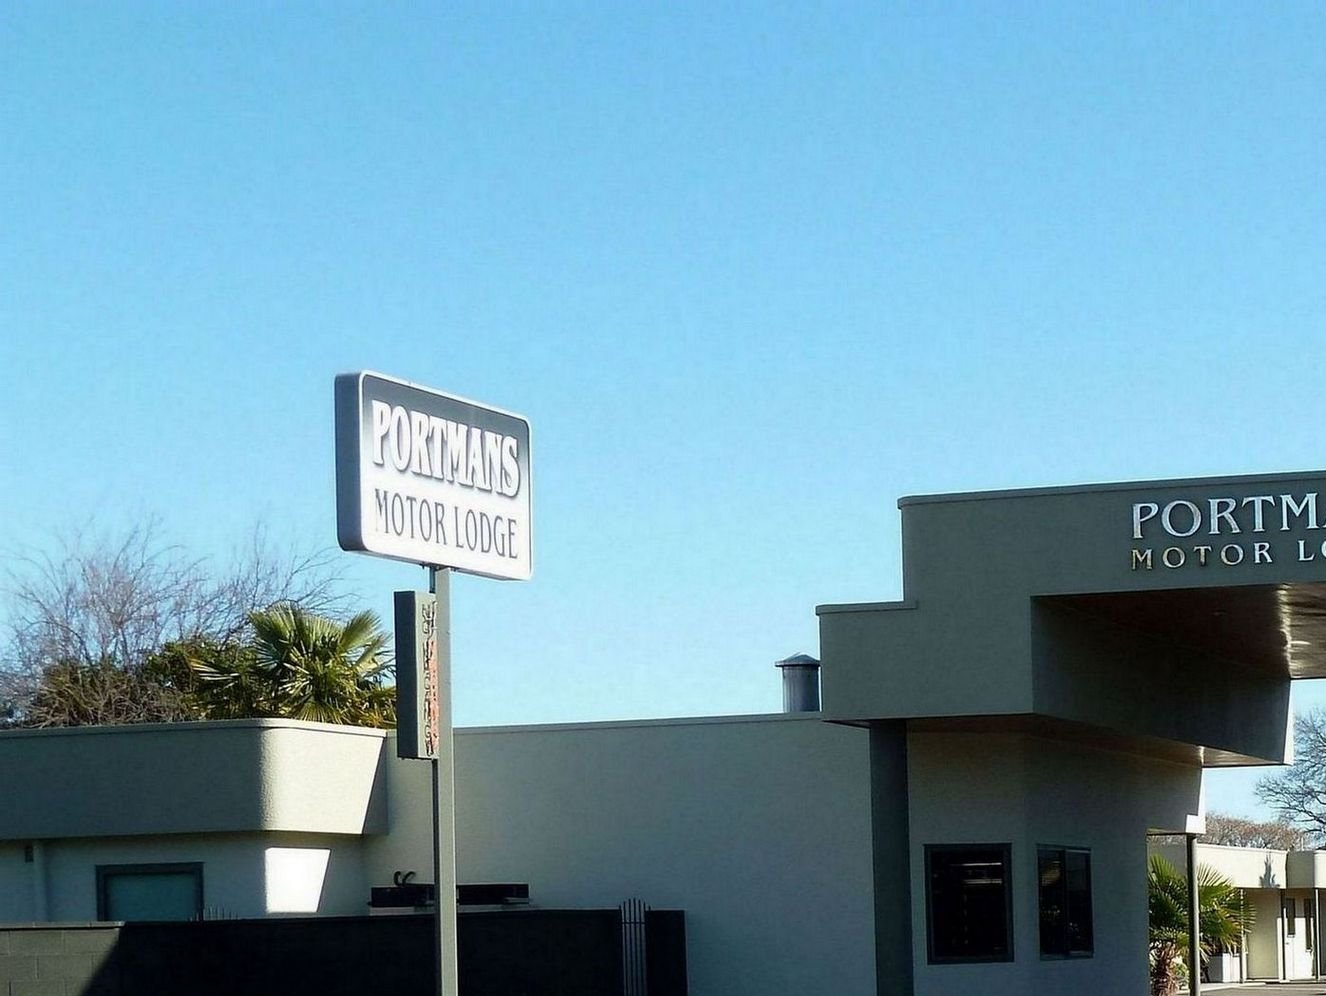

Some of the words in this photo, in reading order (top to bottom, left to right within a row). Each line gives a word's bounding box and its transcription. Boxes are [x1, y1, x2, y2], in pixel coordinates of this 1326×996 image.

[372, 399, 521, 500] PORTMANS
[375, 488, 448, 546] MOTOR
[454, 506, 519, 559] LODGE
[1131, 541, 1273, 570] MOTOR
